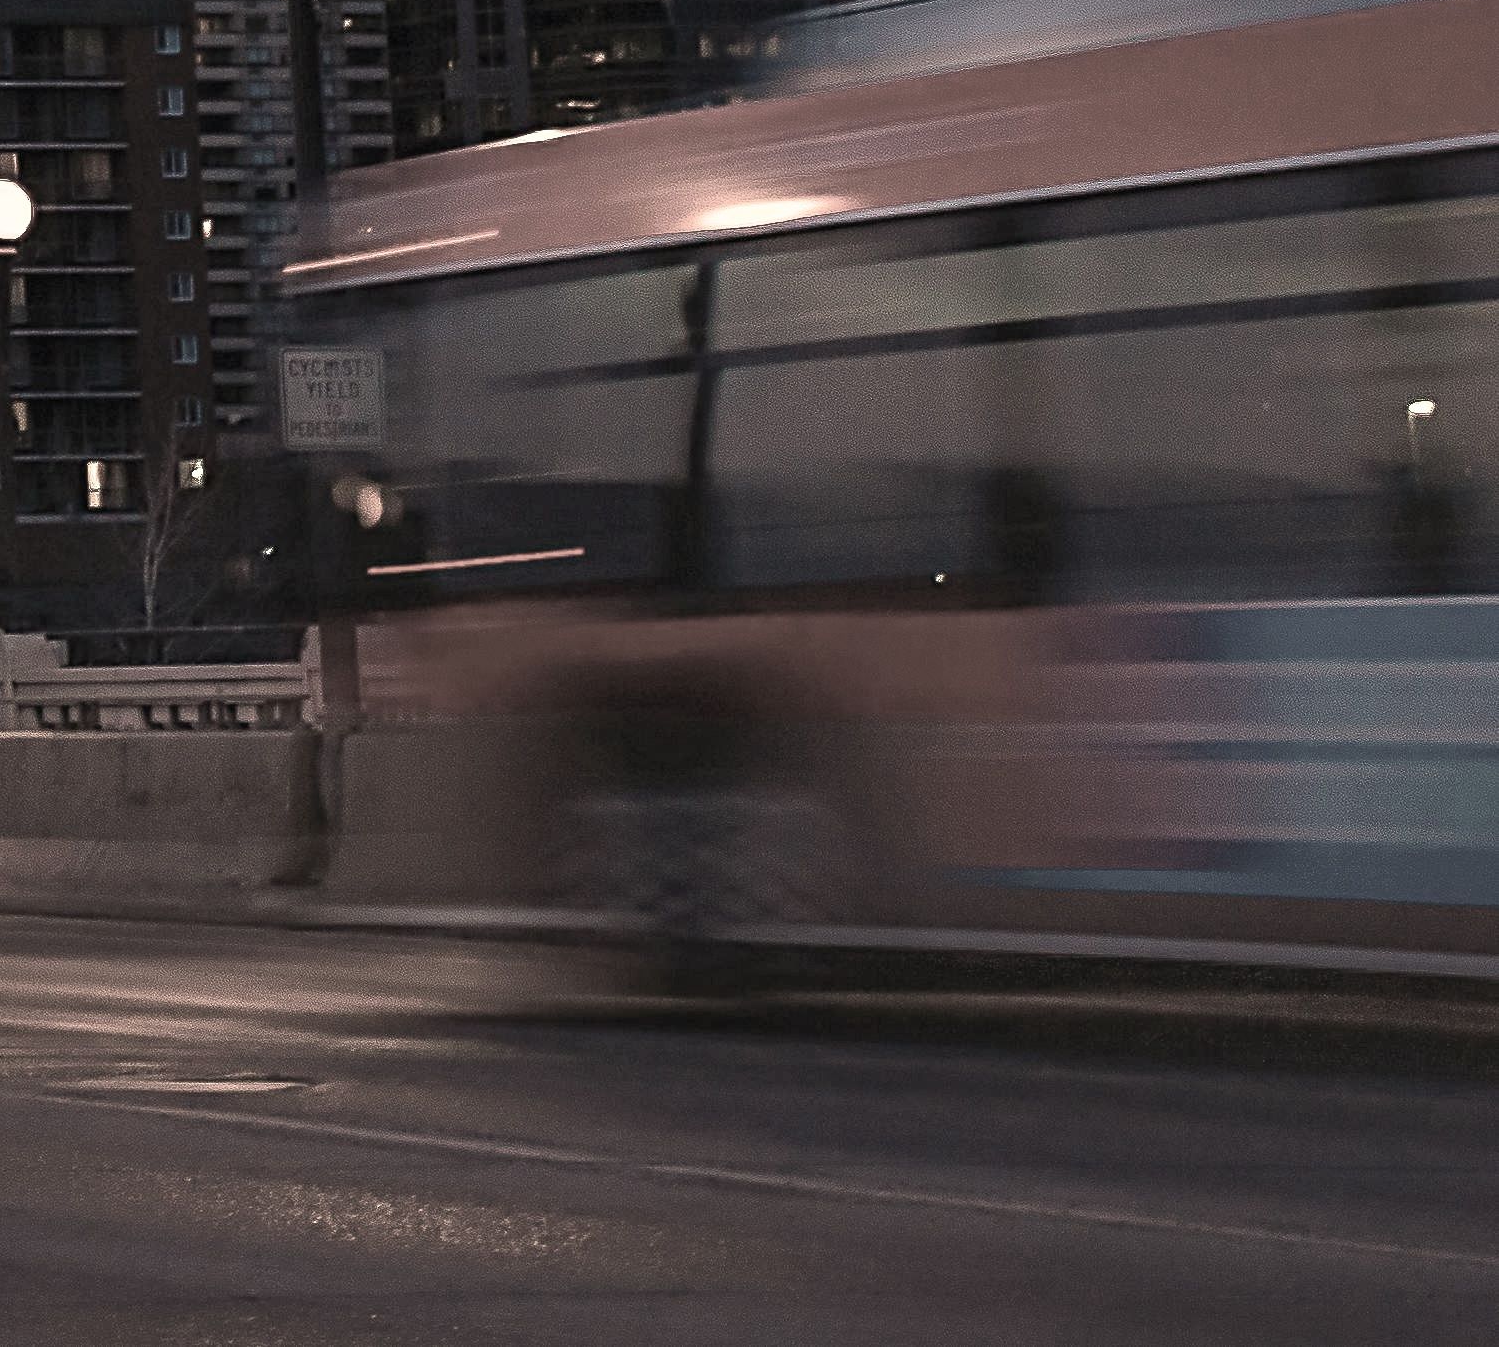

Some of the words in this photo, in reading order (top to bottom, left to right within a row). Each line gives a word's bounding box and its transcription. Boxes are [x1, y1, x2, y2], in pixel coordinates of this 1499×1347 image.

[288, 358, 375, 377] CYCLISTS
[306, 381, 361, 399] YIELD
[326, 402, 343, 417] TO
[290, 420, 379, 439] PEDESTRIANS
